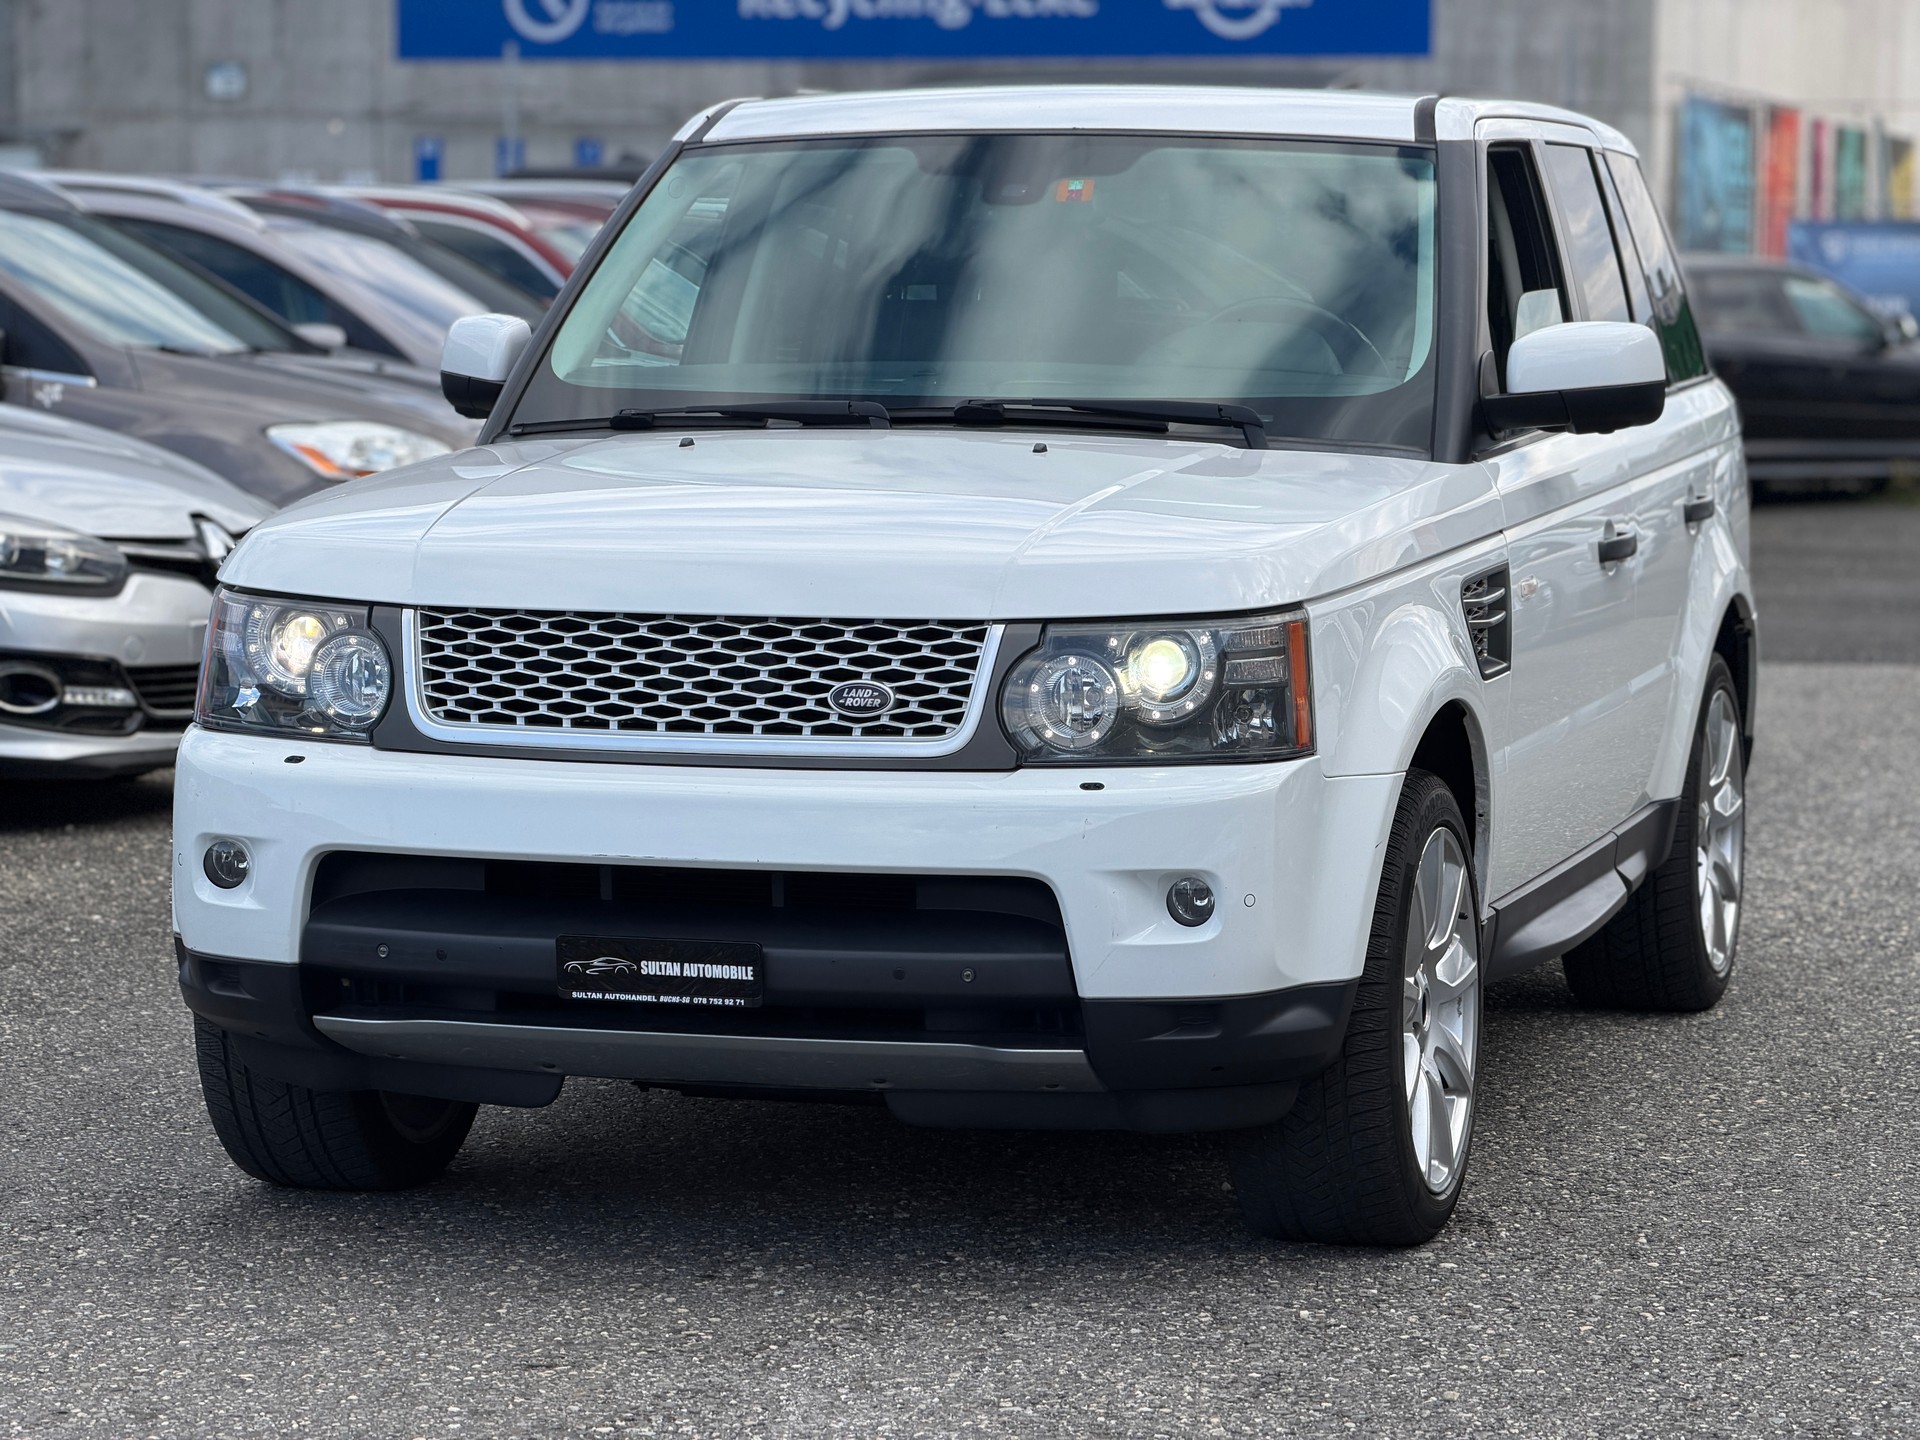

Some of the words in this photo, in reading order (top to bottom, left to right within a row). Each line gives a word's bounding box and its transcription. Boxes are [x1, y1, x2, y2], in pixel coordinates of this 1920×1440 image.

[842, 688, 873, 698] LAND
[844, 697, 881, 707] ROVER
[641, 960, 681, 976] SULTAN
[683, 964, 754, 981] AUTOMOBILE
[571, 991, 602, 999] SULTAN
[604, 993, 657, 1002] AUTOHANDEL
[693, 997, 707, 1005] 078
